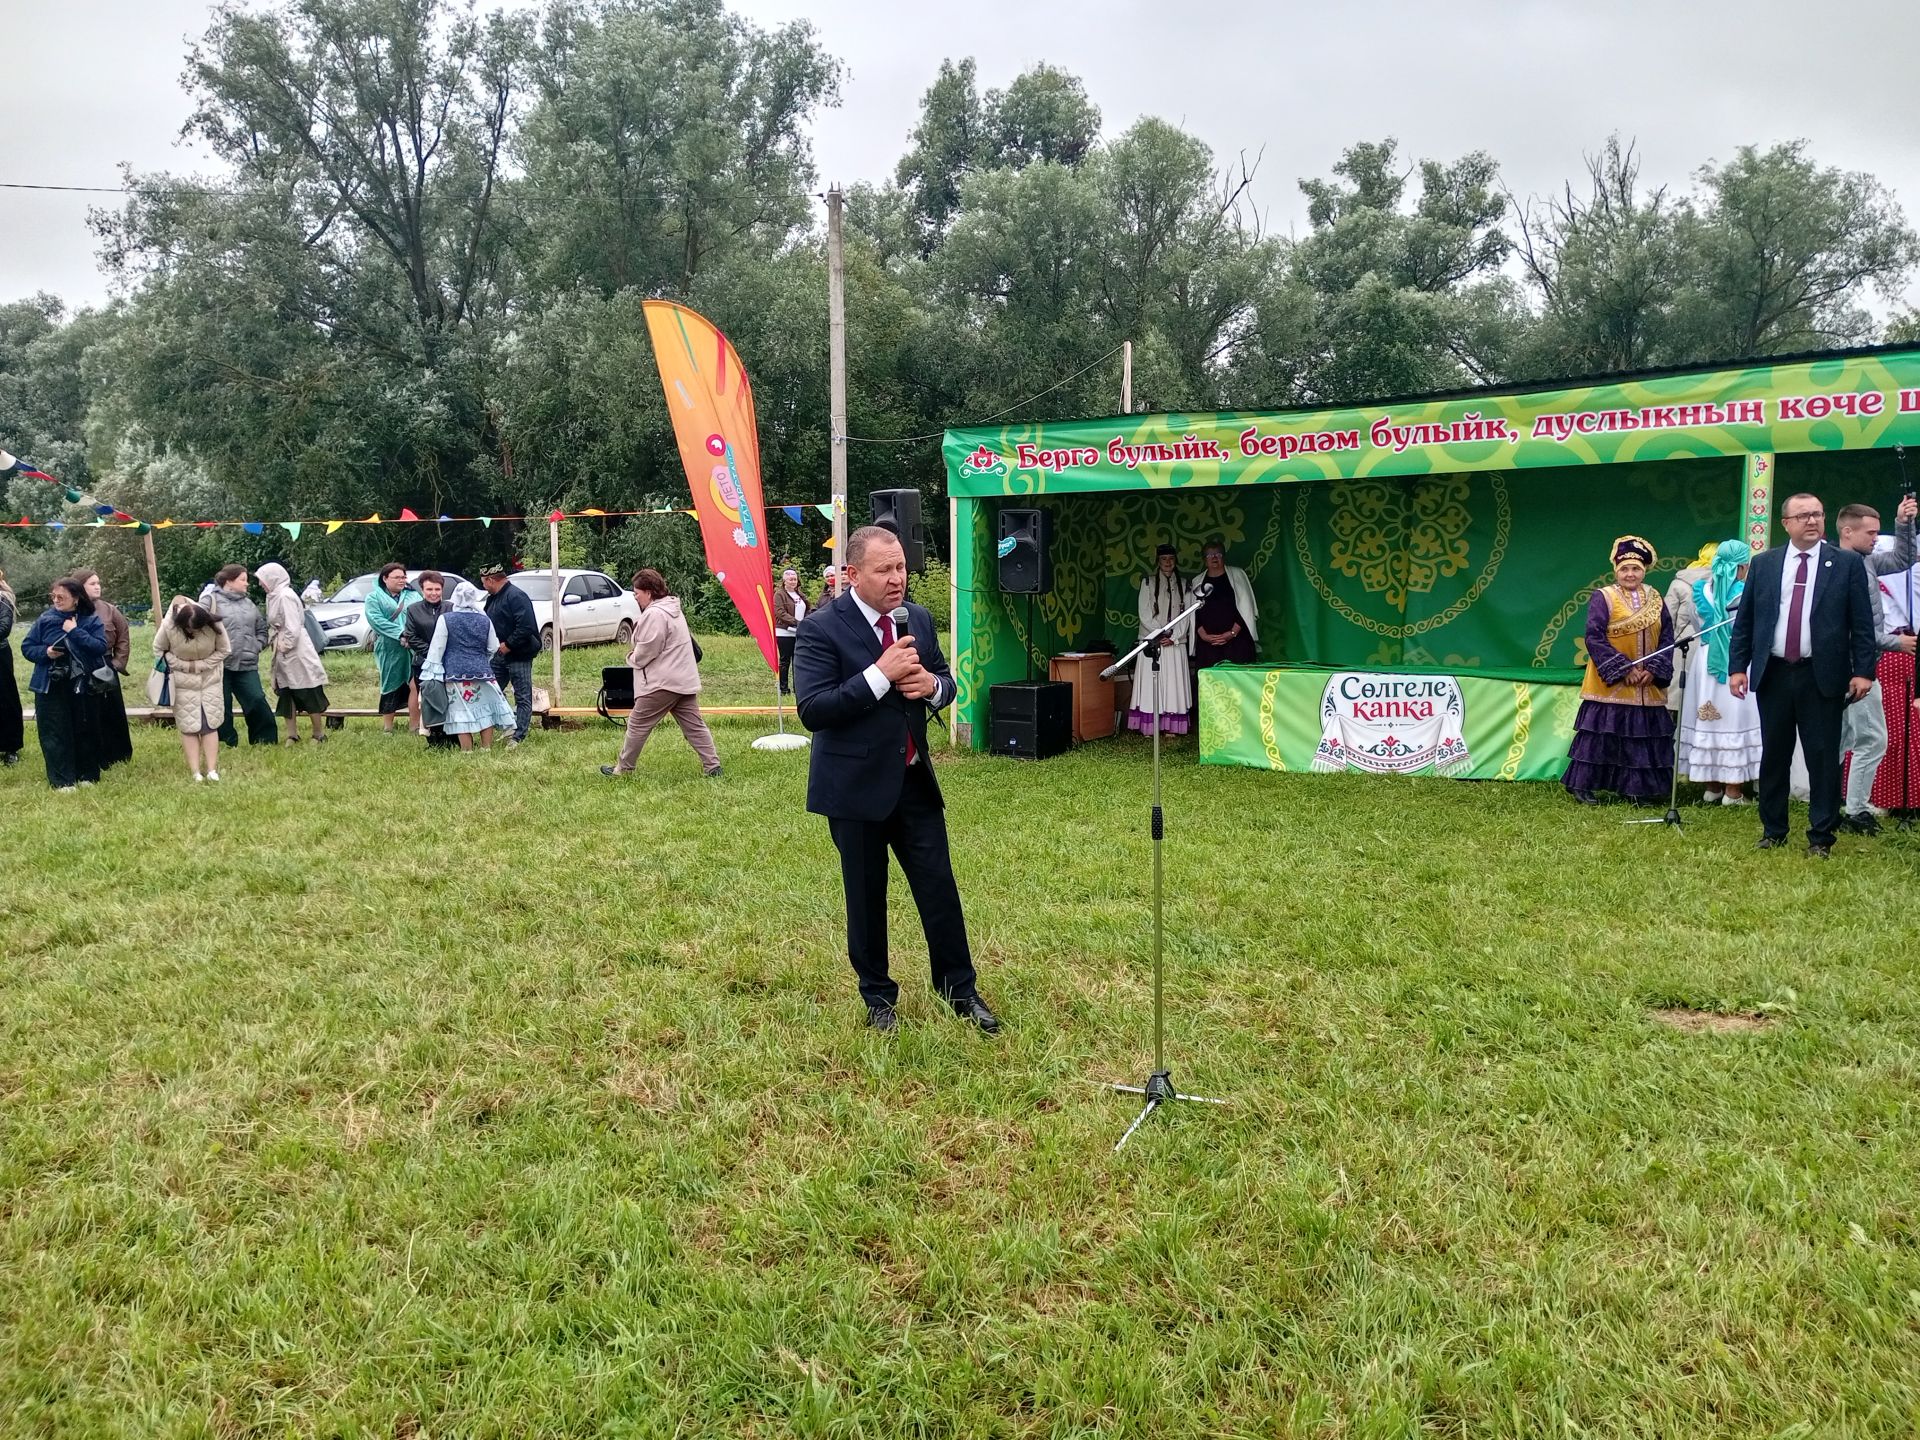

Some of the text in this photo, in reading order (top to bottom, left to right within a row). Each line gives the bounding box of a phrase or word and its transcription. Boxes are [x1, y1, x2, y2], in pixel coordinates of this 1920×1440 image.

[1016, 443, 1099, 473] Бергә
[1108, 433, 1229, 469] булыйк,
[1240, 427, 1360, 459] бердәм
[1371, 412, 1518, 452] булыйк,
[1533, 400, 1764, 441] дуслыкның
[1779, 393, 1883, 420] көче
[717, 472, 737, 500] ЛЕТО
[747, 531, 755, 539] В
[1340, 676, 1447, 700] Сөлгеле
[1352, 701, 1434, 721] капка
